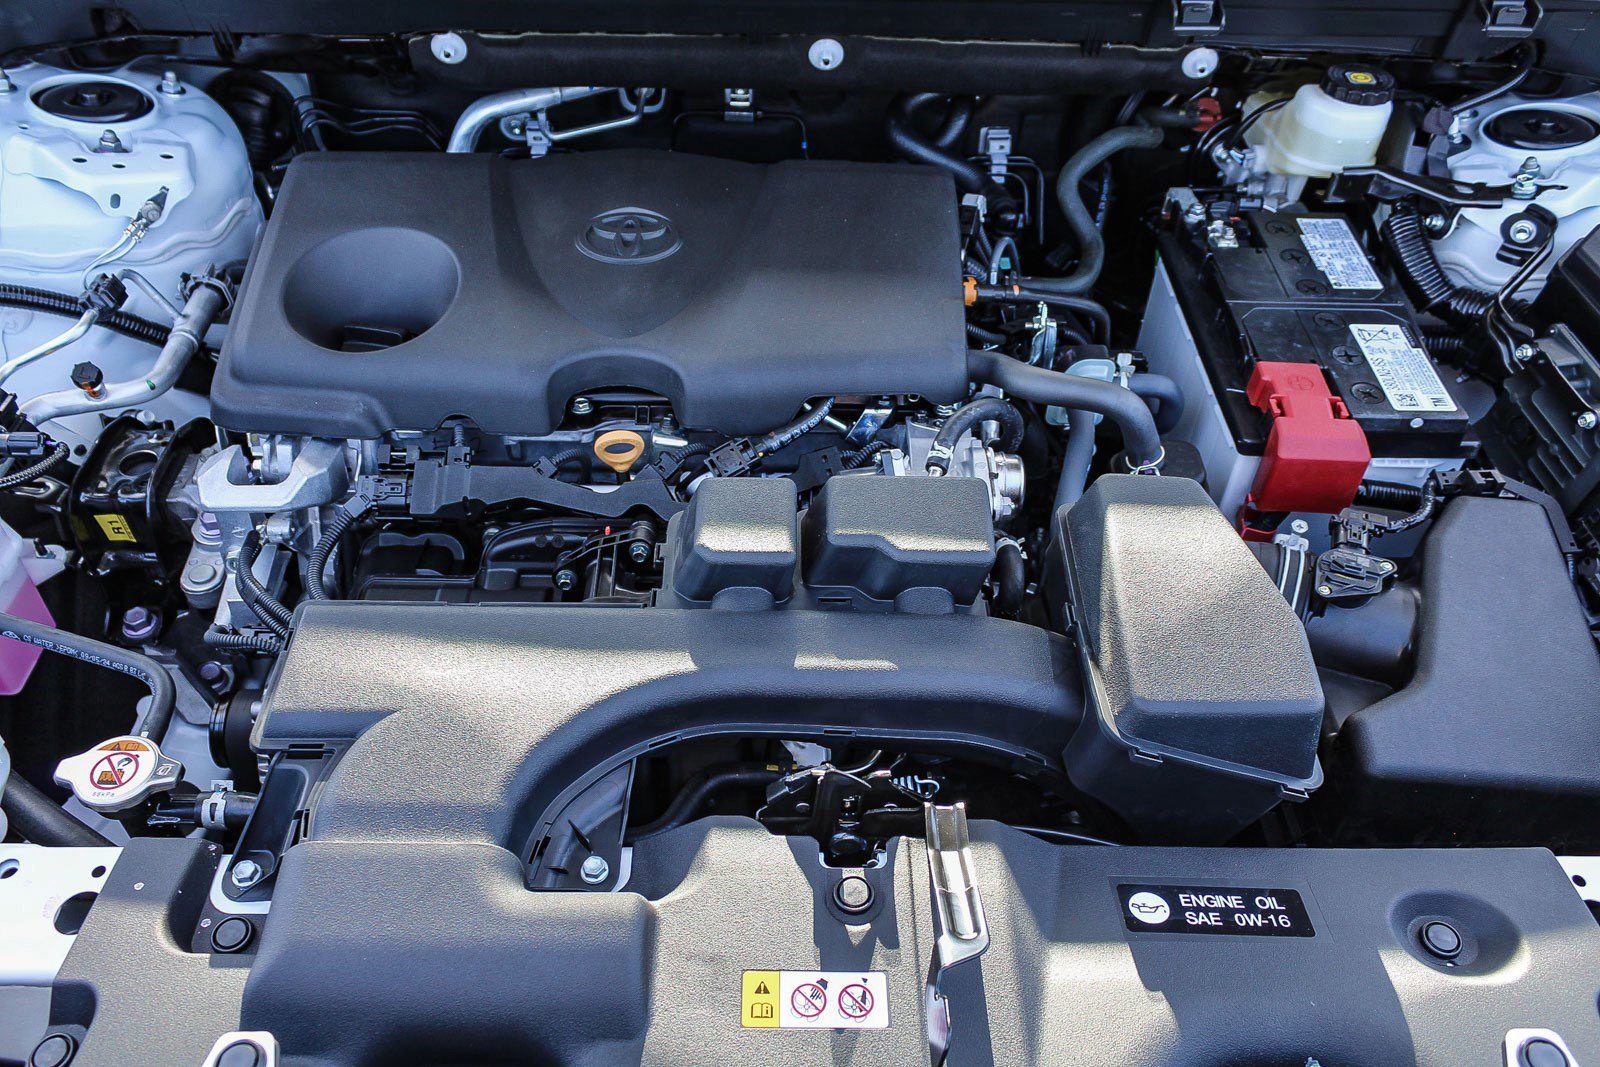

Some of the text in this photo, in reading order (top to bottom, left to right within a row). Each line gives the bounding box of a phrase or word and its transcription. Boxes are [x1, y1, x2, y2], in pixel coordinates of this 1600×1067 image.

[107, 520, 125, 535] R1
[1178, 893, 1286, 910] ENGINE OIL
[1184, 911, 1291, 928] SAE 0W-16
